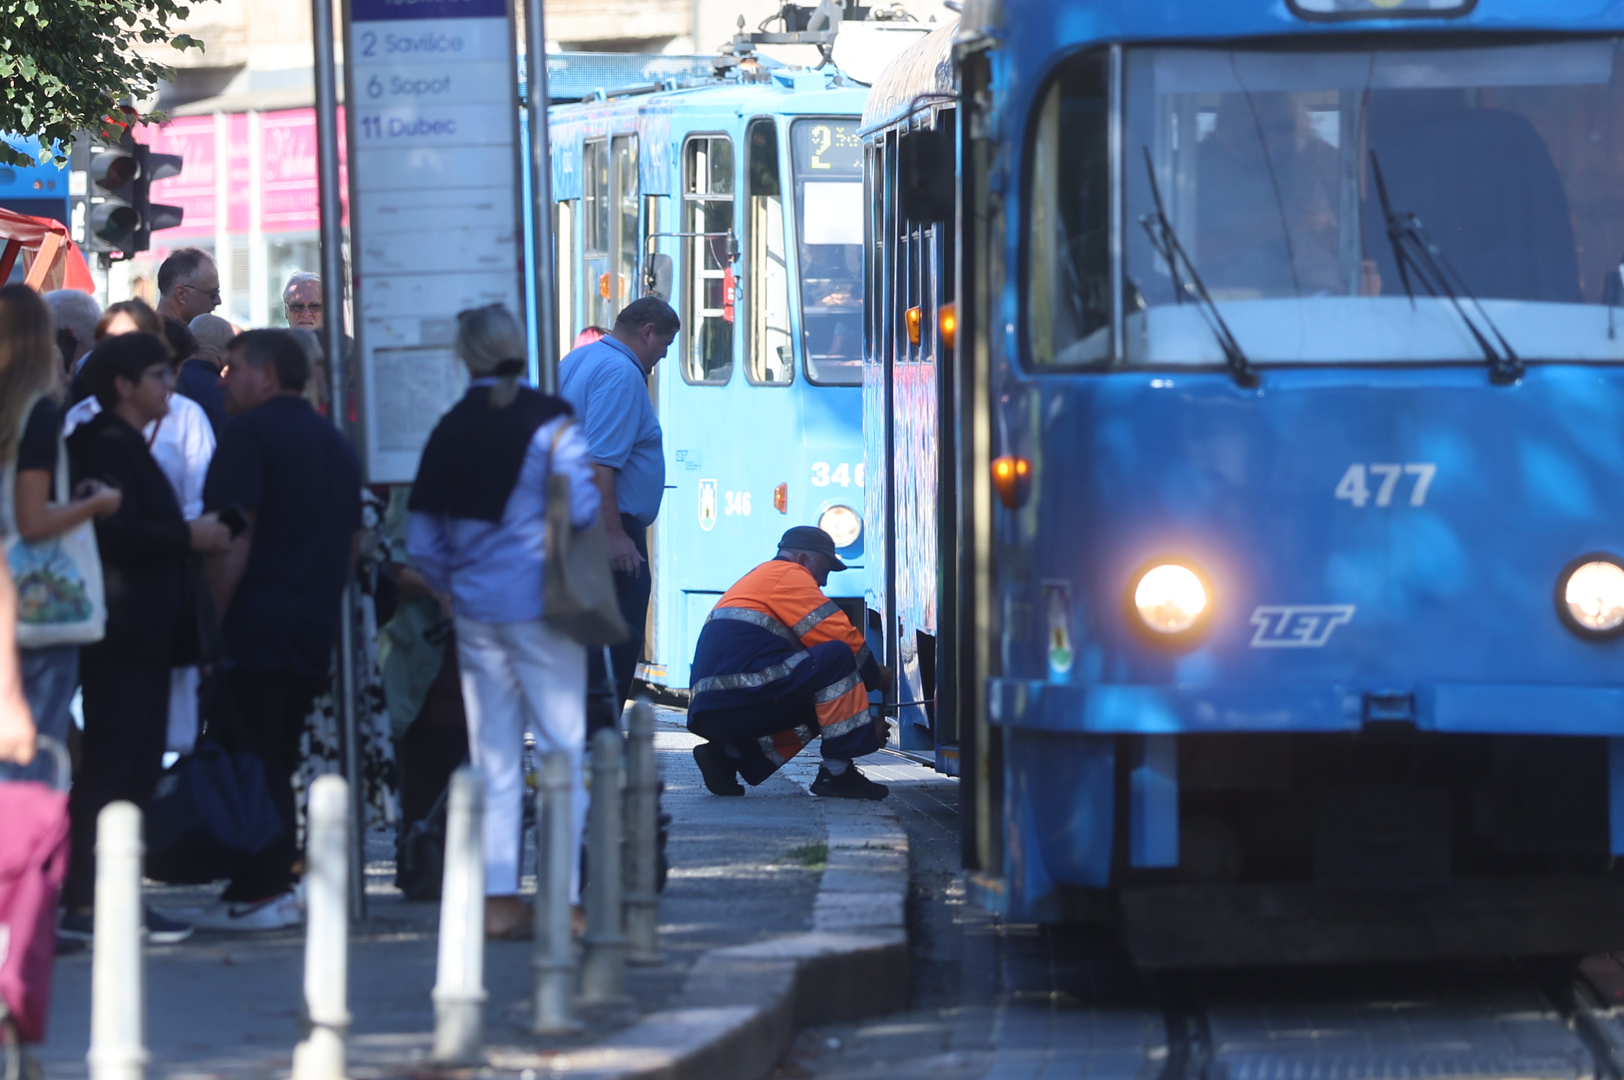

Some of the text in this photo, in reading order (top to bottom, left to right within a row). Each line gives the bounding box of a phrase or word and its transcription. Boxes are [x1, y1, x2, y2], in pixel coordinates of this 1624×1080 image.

[361, 31, 377, 57] 2
[366, 74, 384, 99] 6
[361, 116, 457, 138] 11 Dubec
[811, 125, 831, 169] 2
[1335, 464, 1437, 507] 477
[725, 491, 751, 516] 346
[1250, 605, 1356, 647] ZET
